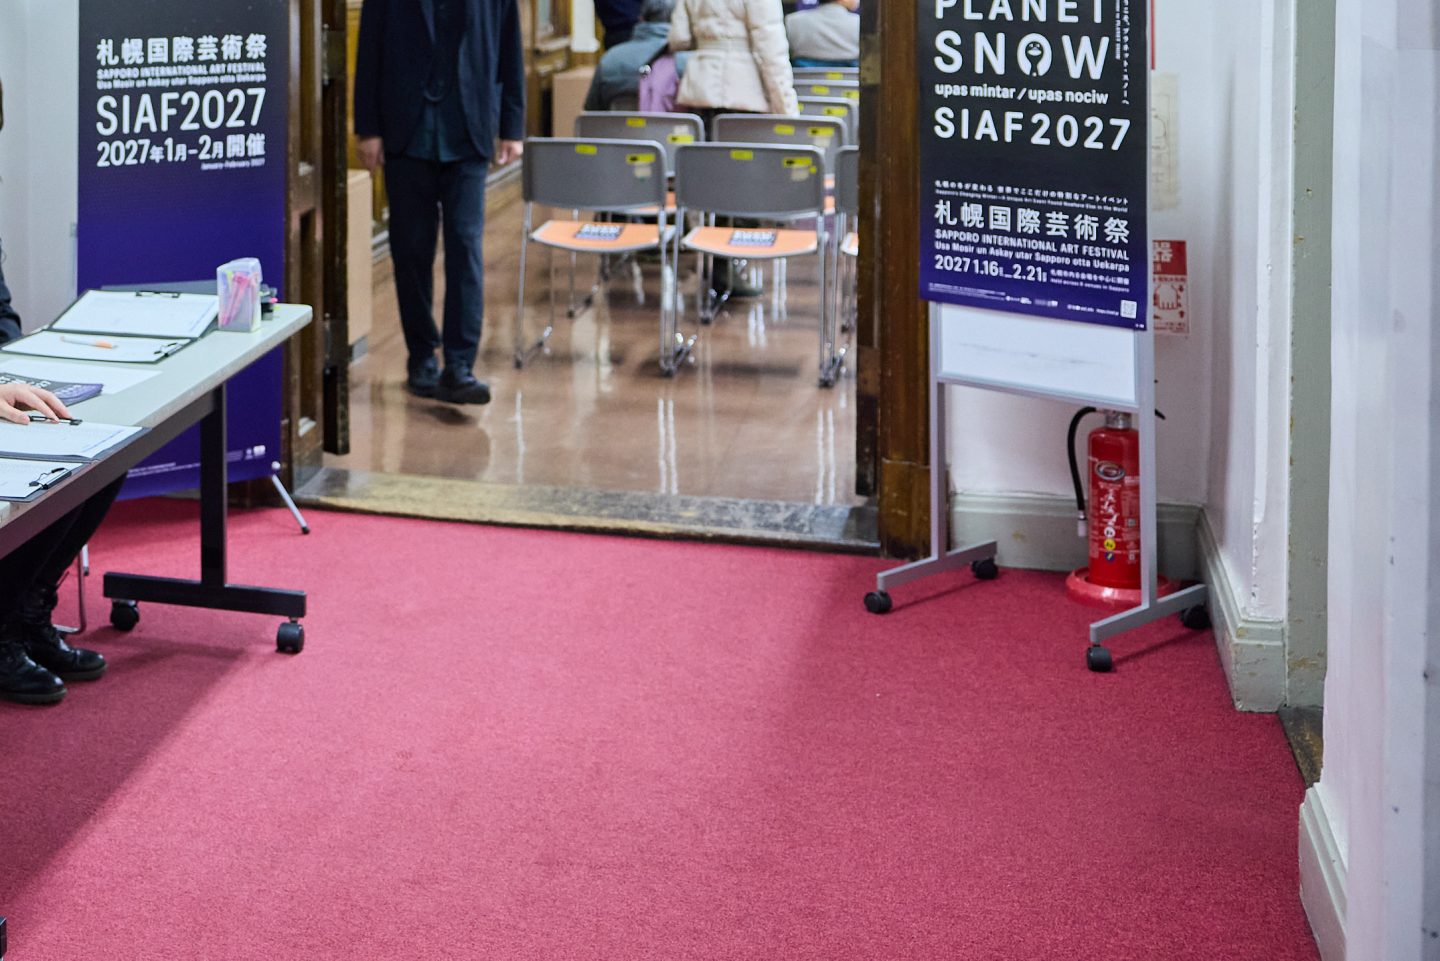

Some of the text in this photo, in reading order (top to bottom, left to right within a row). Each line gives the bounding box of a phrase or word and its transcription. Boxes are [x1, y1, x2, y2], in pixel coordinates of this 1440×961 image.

[96, 33, 267, 66] 札幌国際芸術祭
[934, 30, 1109, 80] SNOW
[96, 87, 266, 136] SIAF2027
[934, 83, 968, 98] upas
[970, 83, 1016, 99] mintar
[1028, 88, 1062, 104] upas
[1065, 89, 1109, 105] nociw
[934, 107, 1130, 151] SIAF2027
[934, 199, 1130, 244] 札幌国際芸術祭
[934, 240, 950, 250] Usa
[951, 242, 974, 253] Mosir
[976, 246, 987, 255] un
[1034, 252, 1070, 264] Sapporo
[935, 228, 1129, 260] SAPPORO INTERNATIONAL ART FESTIVAL
